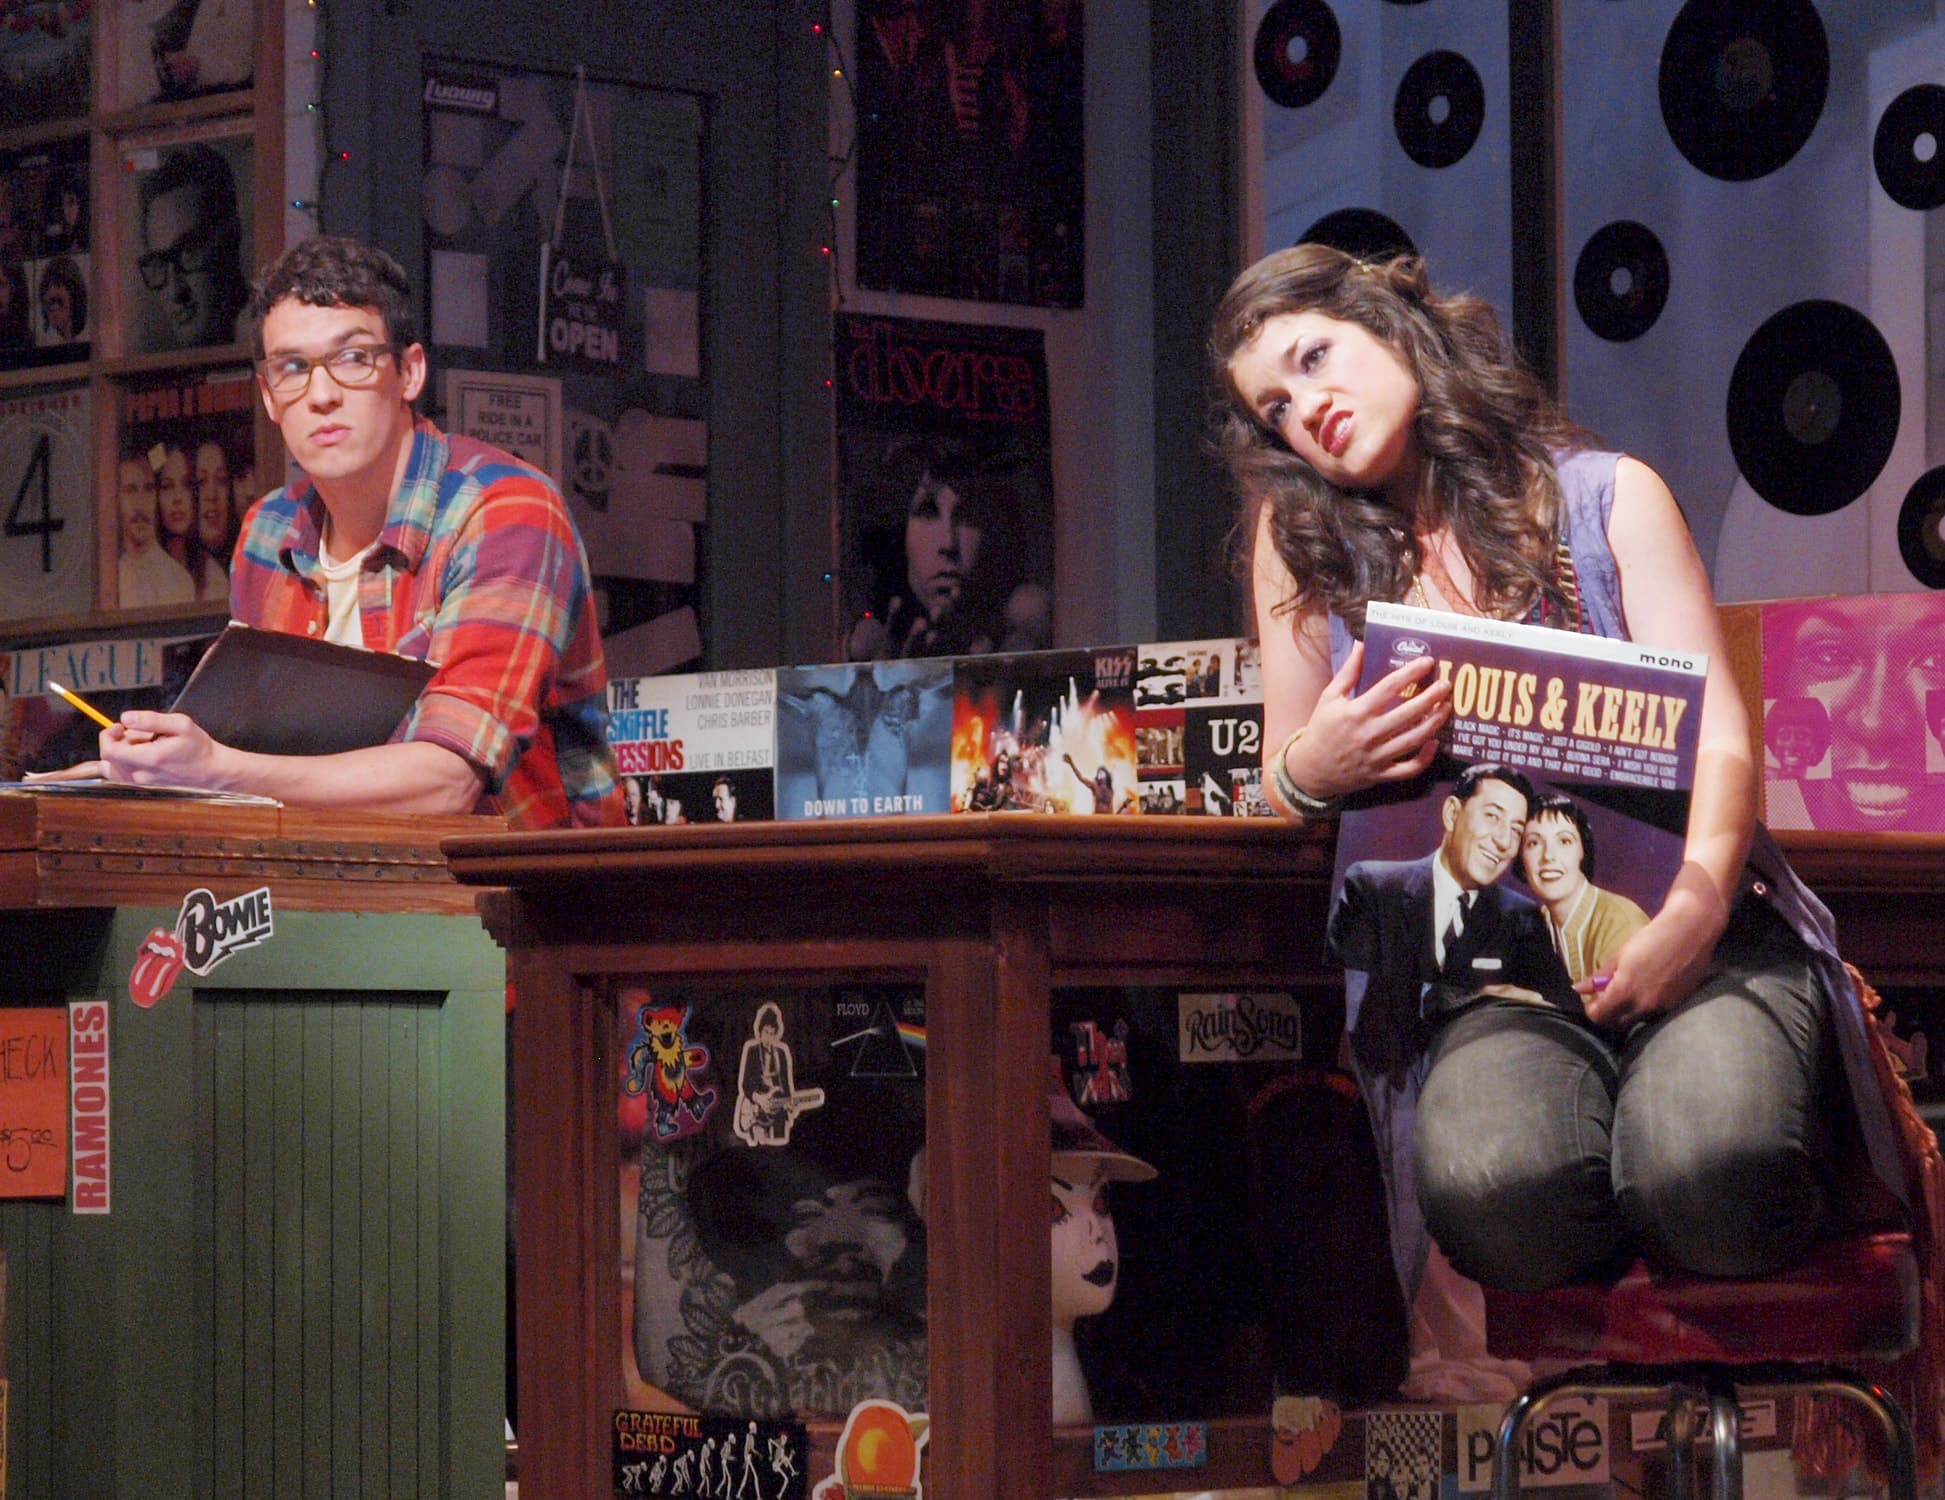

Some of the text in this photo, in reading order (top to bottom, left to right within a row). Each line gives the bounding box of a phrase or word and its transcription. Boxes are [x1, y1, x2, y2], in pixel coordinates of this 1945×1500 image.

[550, 317, 618, 364] OPEN
[489, 393, 521, 409] FREE
[478, 411, 533, 428] RIDE IN A
[469, 428, 542, 447] POLICE CAR
[4, 435, 64, 572] 4
[13, 639, 157, 696] LEAGUE
[1095, 656, 1132, 678] KISS
[1639, 653, 1694, 671] mono
[697, 669, 773, 689] VAN MORRISON
[610, 679, 641, 709] THE
[685, 690, 773, 711] LONNIE DONEGAN
[697, 710, 772, 730] CHRIS BARBER
[1540, 677, 1569, 731] &
[1572, 682, 1688, 750] KEELY
[1208, 718, 1260, 756] U2
[611, 739, 685, 774] ESSIONS
[688, 749, 770, 770] LIVE IN BELFAST
[804, 795, 924, 817] DOWN TO EARTH
[177, 889, 272, 969] BOWIE
[836, 1002, 870, 1016] FLOYD
[73, 1004, 107, 1209] RAMONES
[615, 1410, 701, 1438] GRATEFUL
[619, 1432, 677, 1455] DEAD
